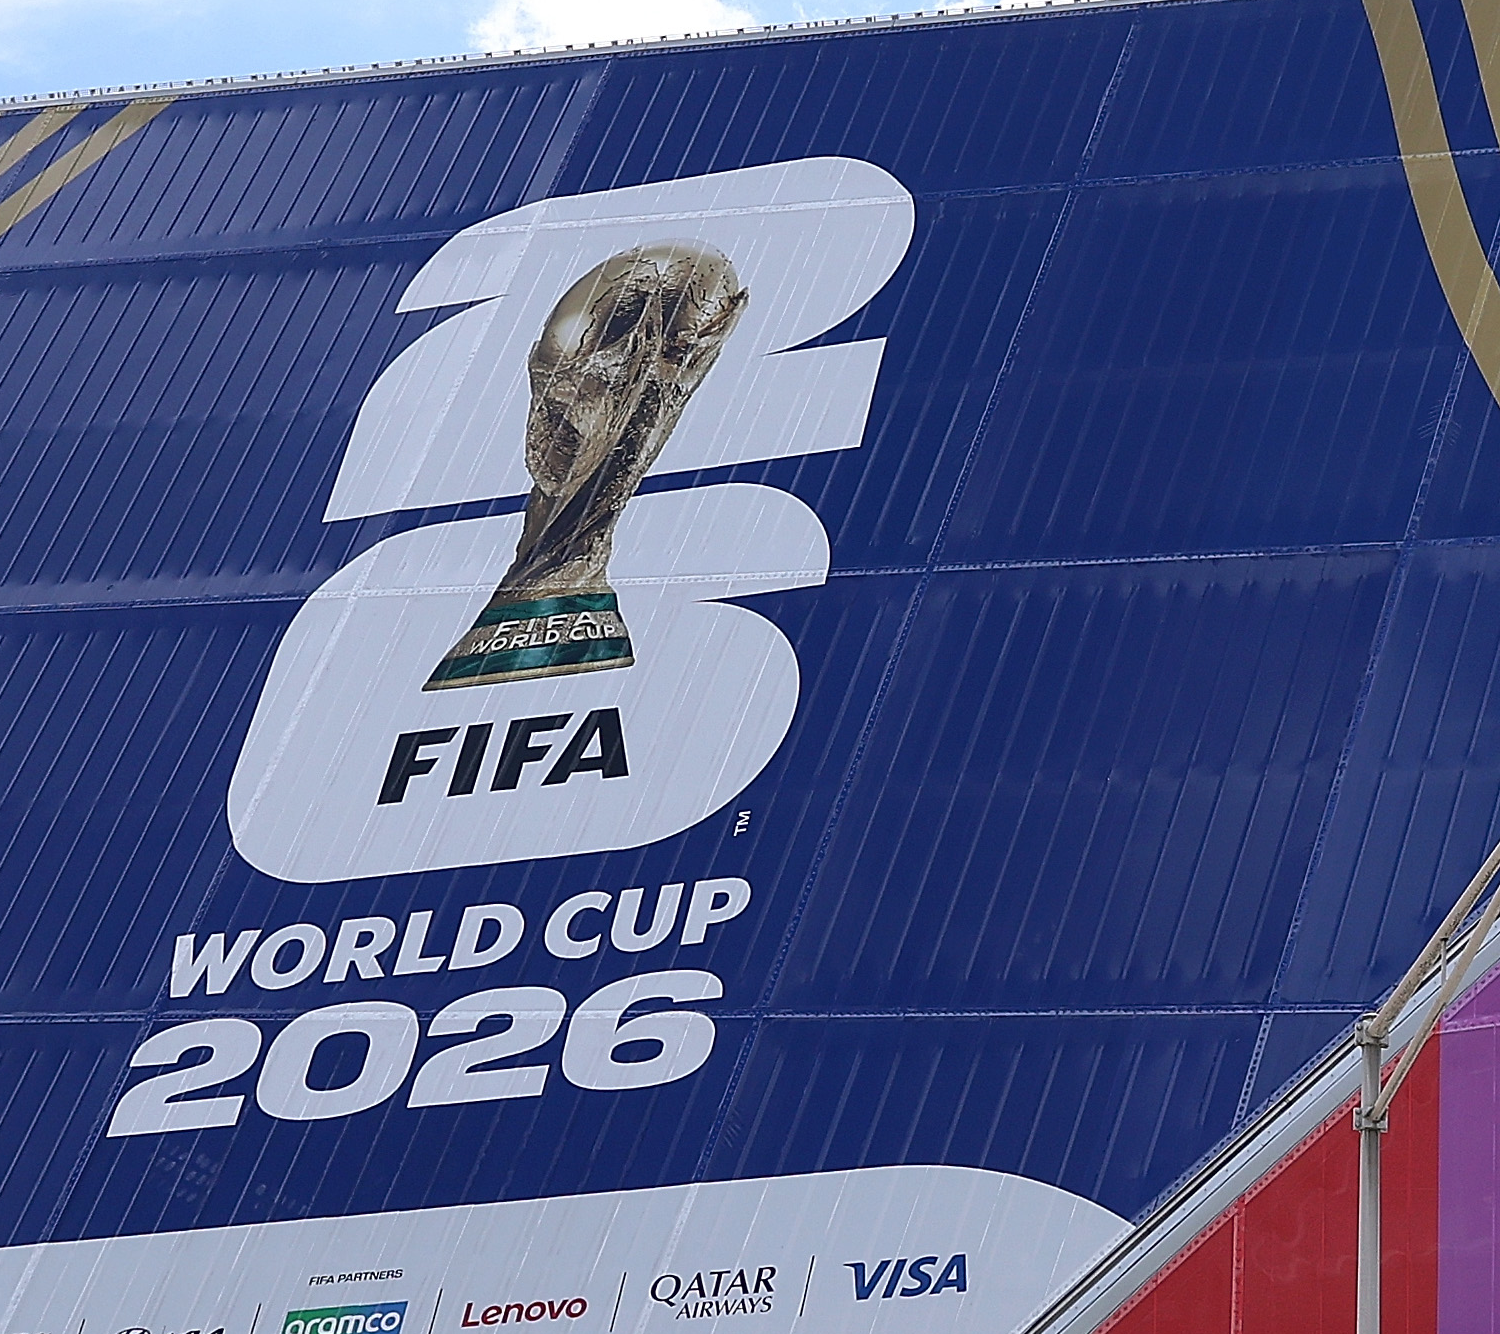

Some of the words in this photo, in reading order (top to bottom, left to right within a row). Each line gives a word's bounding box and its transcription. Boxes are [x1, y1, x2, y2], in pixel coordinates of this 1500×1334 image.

[469, 629, 560, 655] WORLD
[568, 625, 616, 641] CUP
[494, 611, 599, 638] FIFA
[377, 707, 630, 806] FIFA
[168, 902, 525, 998] WORLD
[543, 877, 752, 960] CUP
[106, 969, 724, 1138] 2026
[309, 1275, 335, 1286] FIFA
[337, 1269, 404, 1284] PARTNERS
[650, 1266, 777, 1306] QATAR
[842, 1253, 968, 1301] VISA
[461, 1297, 588, 1328] Lenovo
[675, 1296, 773, 1320] AIRWAYS
